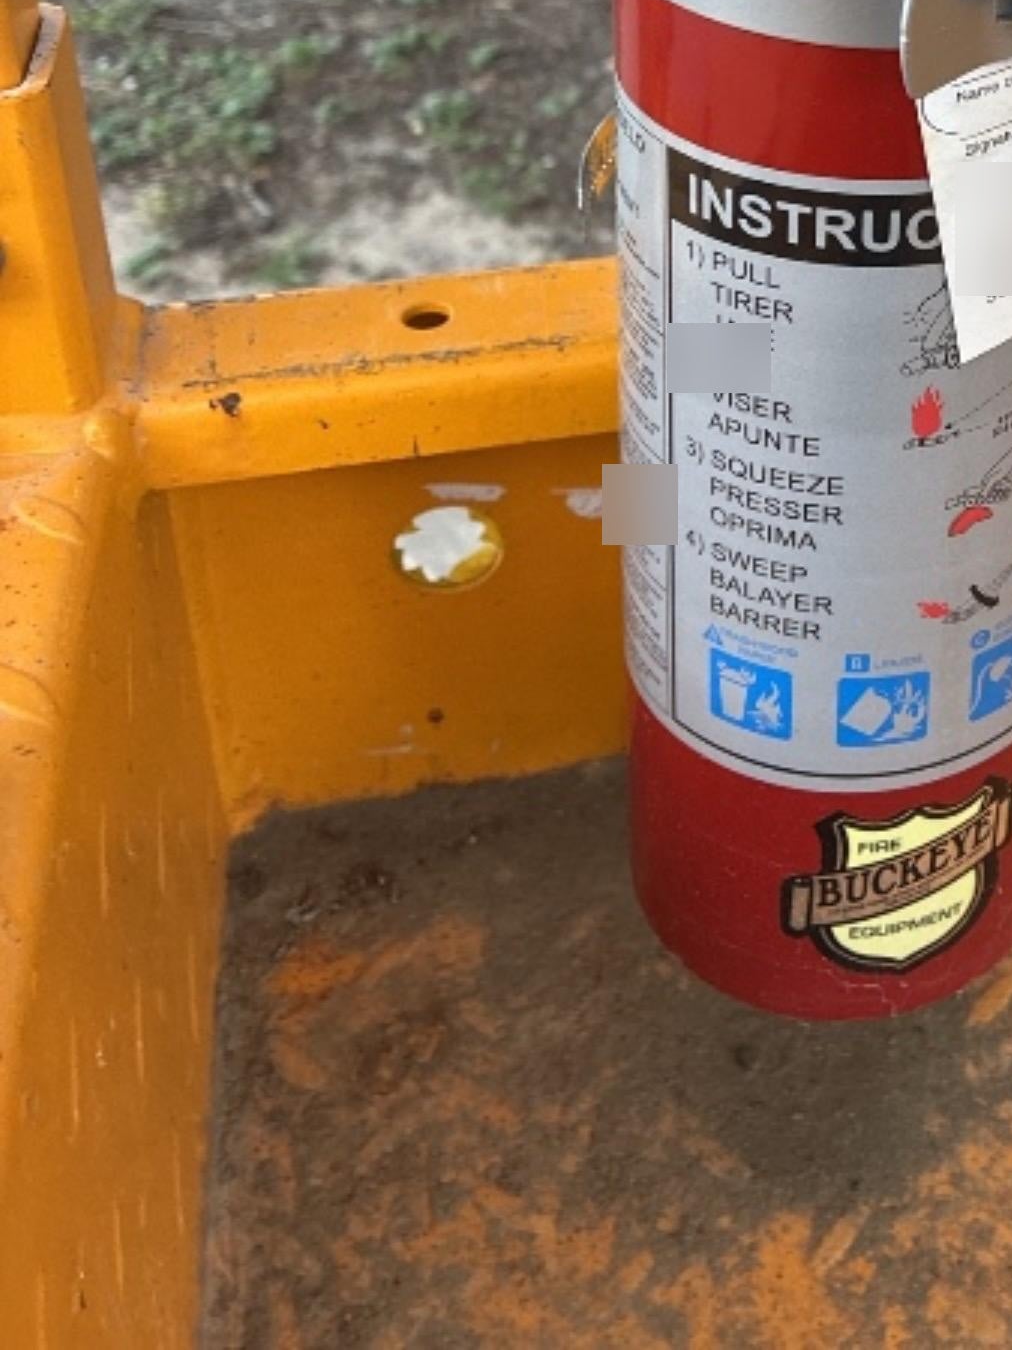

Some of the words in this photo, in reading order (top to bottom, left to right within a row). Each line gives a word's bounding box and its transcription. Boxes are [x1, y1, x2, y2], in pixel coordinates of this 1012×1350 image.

[686, 240, 705, 270] 1)
[712, 251, 780, 289] PULL
[710, 281, 794, 325] TIRER
[708, 412, 821, 458] APUNTE
[684, 434, 706, 466] 3)
[710, 449, 845, 497] SQUEEZE
[710, 476, 843, 526] PRESSER
[710, 506, 818, 551] OPRIMA
[712, 541, 808, 584] SWEEP
[710, 566, 834, 616] BALAYER
[710, 593, 821, 641] BARRER
[816, 808, 993, 908] BUCKEYE
[857, 838, 903, 854] FIRE
[847, 902, 963, 941] EQUIPMENT
